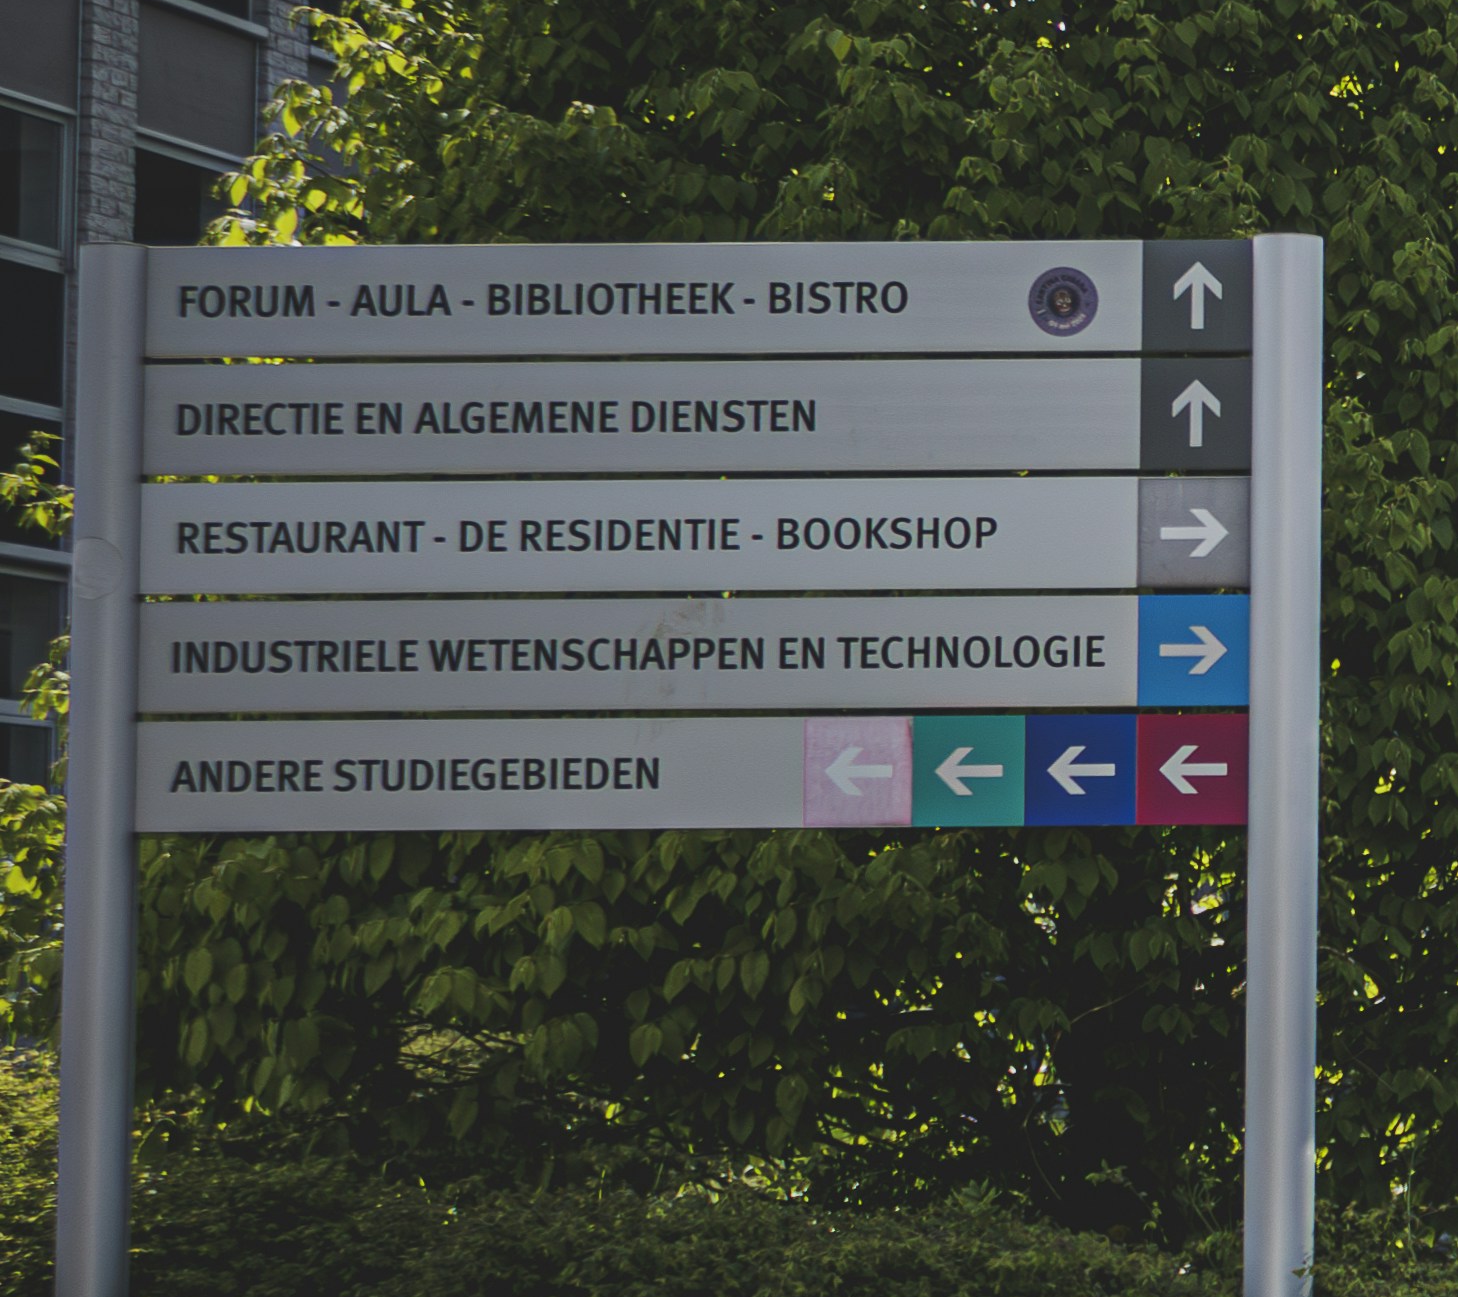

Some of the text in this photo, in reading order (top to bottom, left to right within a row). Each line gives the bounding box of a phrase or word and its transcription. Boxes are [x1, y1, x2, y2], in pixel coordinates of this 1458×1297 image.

[176, 284, 316, 319] FORUM
[349, 283, 452, 317] AULA
[487, 282, 735, 316] BIBLIOTHEEK
[769, 280, 908, 315] BISTRO
[174, 399, 816, 437] DIRECTIE EN ALGEMENE DIENSTEN
[175, 520, 426, 555] RESTAURANT
[459, 520, 508, 553] DE
[520, 518, 741, 552] RESIDENTIE
[777, 516, 998, 550] BOOKSHOP
[169, 635, 1106, 674] INDUSTRIELE WETENSCHAPPEN EN TECHNOLOGIE
[168, 757, 660, 794] ANDERE STUDIEGEBIEDEN
